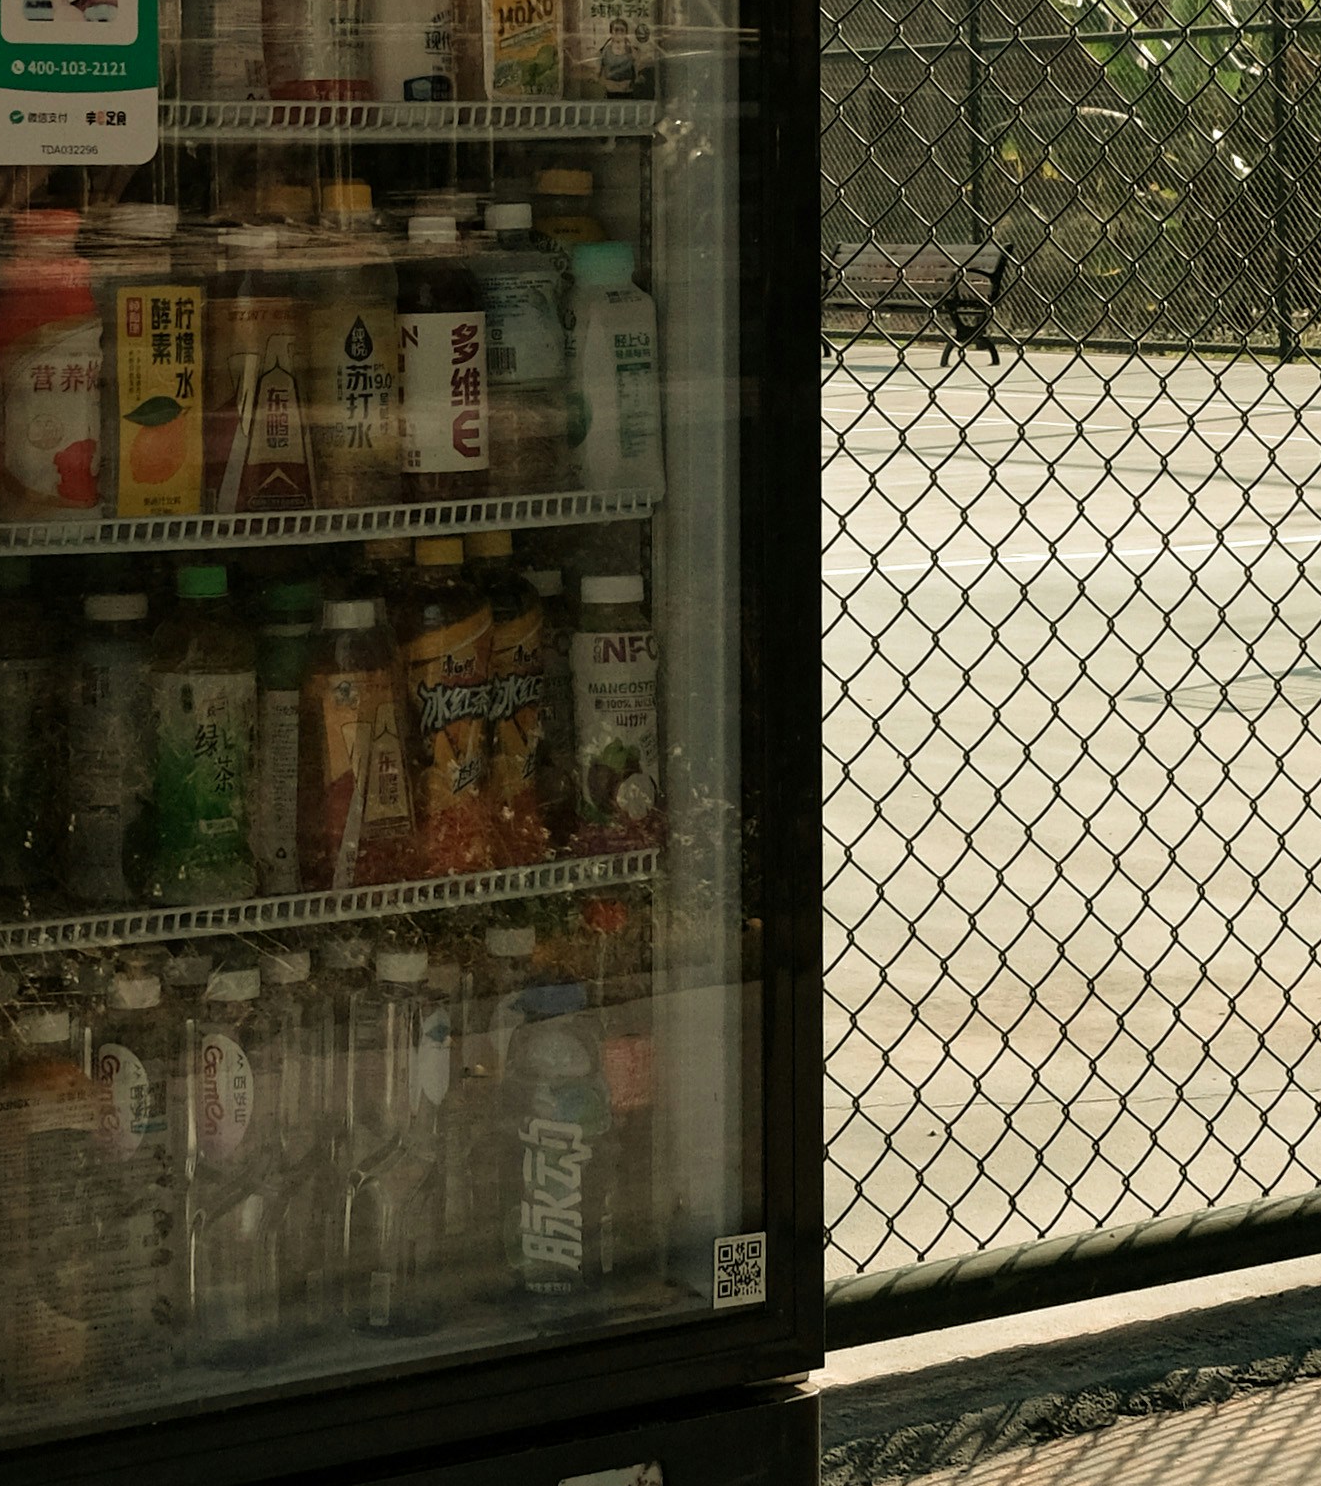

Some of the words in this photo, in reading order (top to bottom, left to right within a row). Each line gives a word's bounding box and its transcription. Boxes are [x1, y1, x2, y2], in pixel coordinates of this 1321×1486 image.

[27, 61, 127, 76] 400-103-2121
[346, 365, 373, 448] 苏打水
